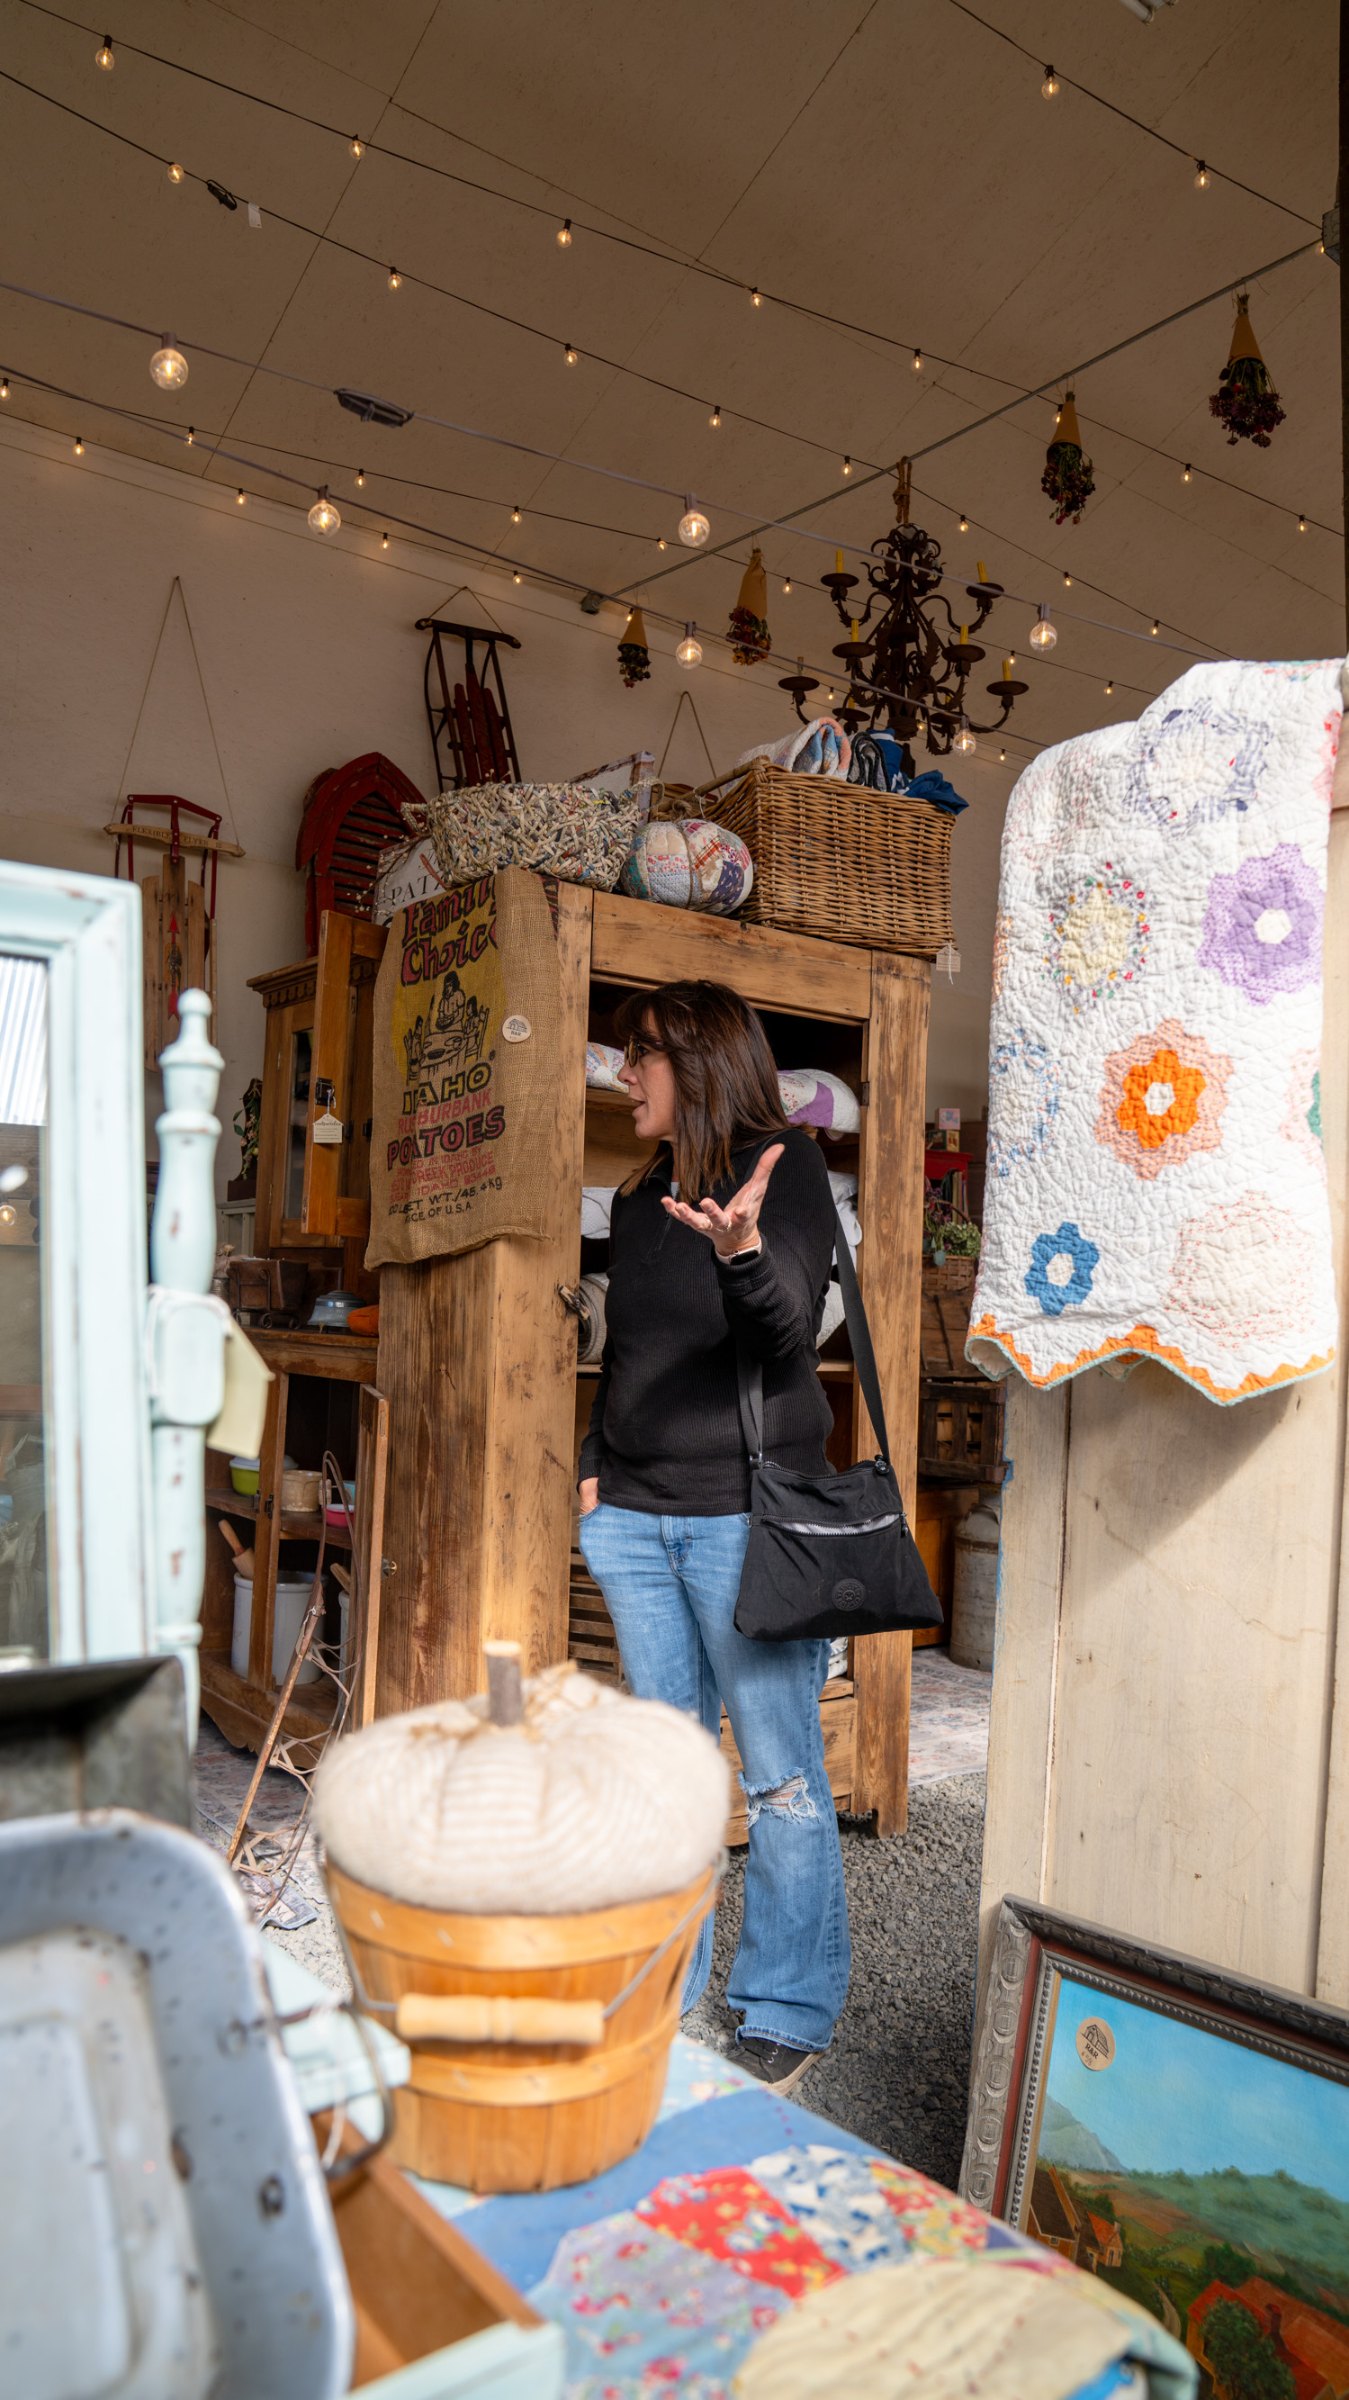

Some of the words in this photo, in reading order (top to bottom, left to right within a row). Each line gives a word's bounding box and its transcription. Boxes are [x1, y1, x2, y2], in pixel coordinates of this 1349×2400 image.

[390, 872, 445, 906] PAT
[402, 1062, 492, 1115] IAHO
[417, 1090, 492, 1126] BURBANK
